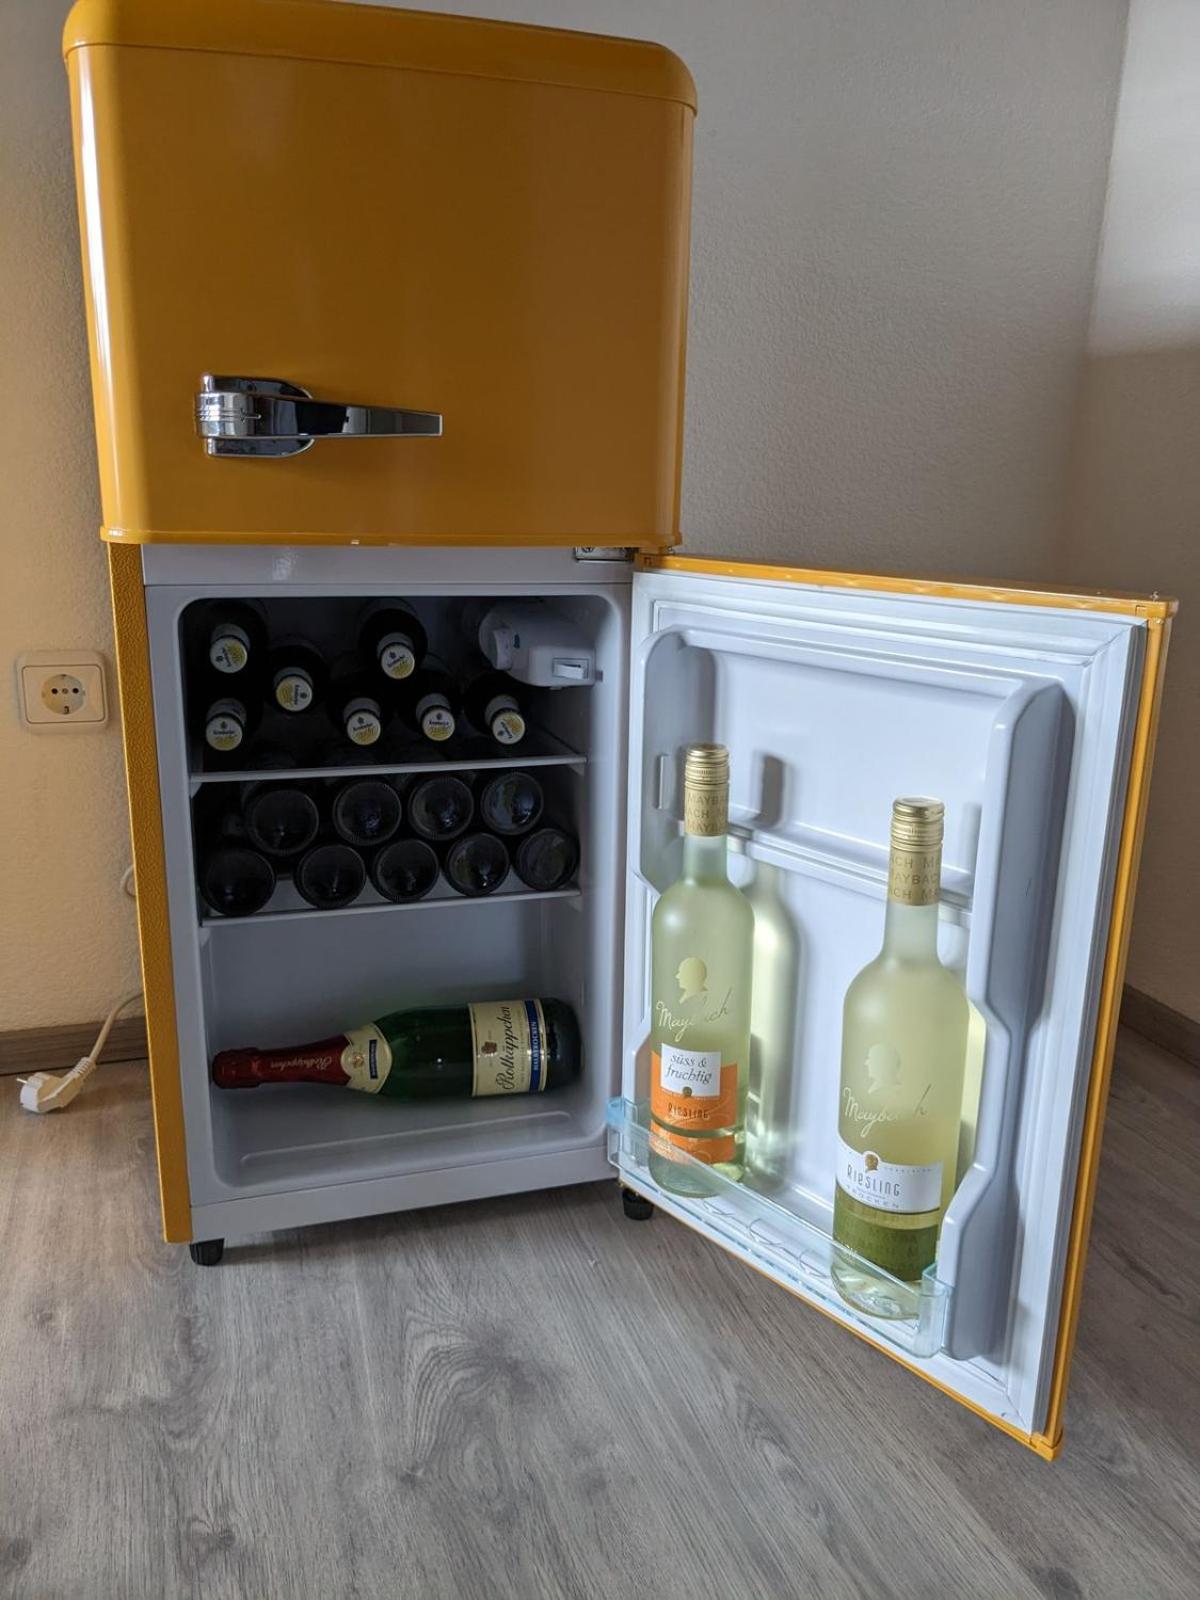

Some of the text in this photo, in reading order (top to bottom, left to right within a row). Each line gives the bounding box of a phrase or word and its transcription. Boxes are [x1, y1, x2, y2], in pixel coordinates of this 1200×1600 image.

[670, 1054, 708, 1068] süss &
[664, 1063, 712, 1085] fruchtig
